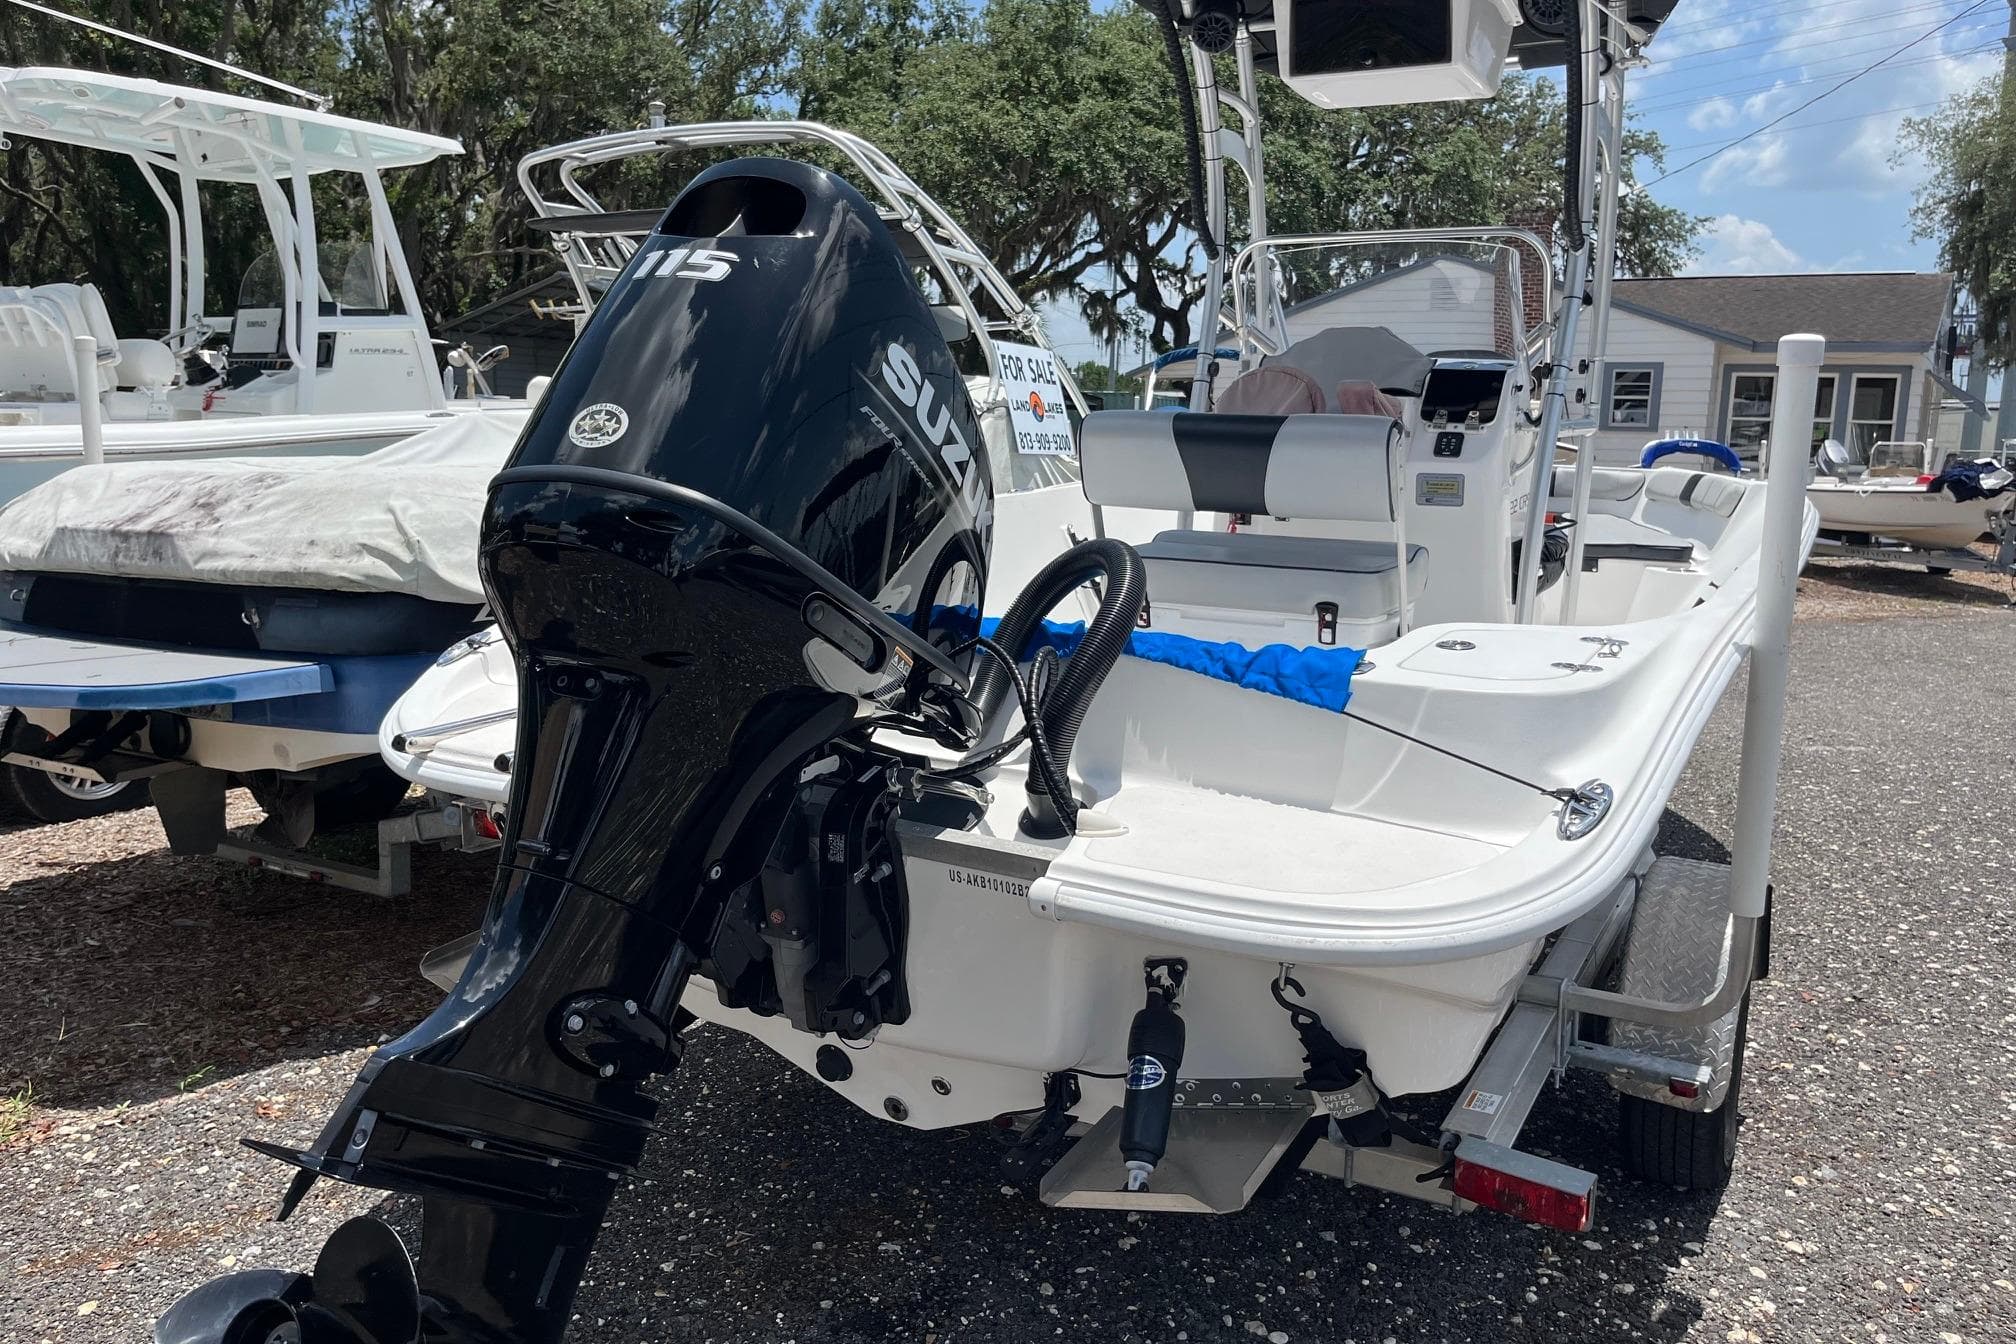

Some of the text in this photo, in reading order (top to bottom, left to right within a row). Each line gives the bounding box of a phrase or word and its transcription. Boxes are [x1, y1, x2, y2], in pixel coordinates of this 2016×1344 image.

[631, 248, 740, 282] 115
[1001, 354, 1057, 385] FOR SALE
[1011, 399, 1030, 412] LAND
[1044, 403, 1064, 414] LAKES
[859, 405, 903, 452] FOUR
[1018, 432, 1071, 451] 813-909-9200
